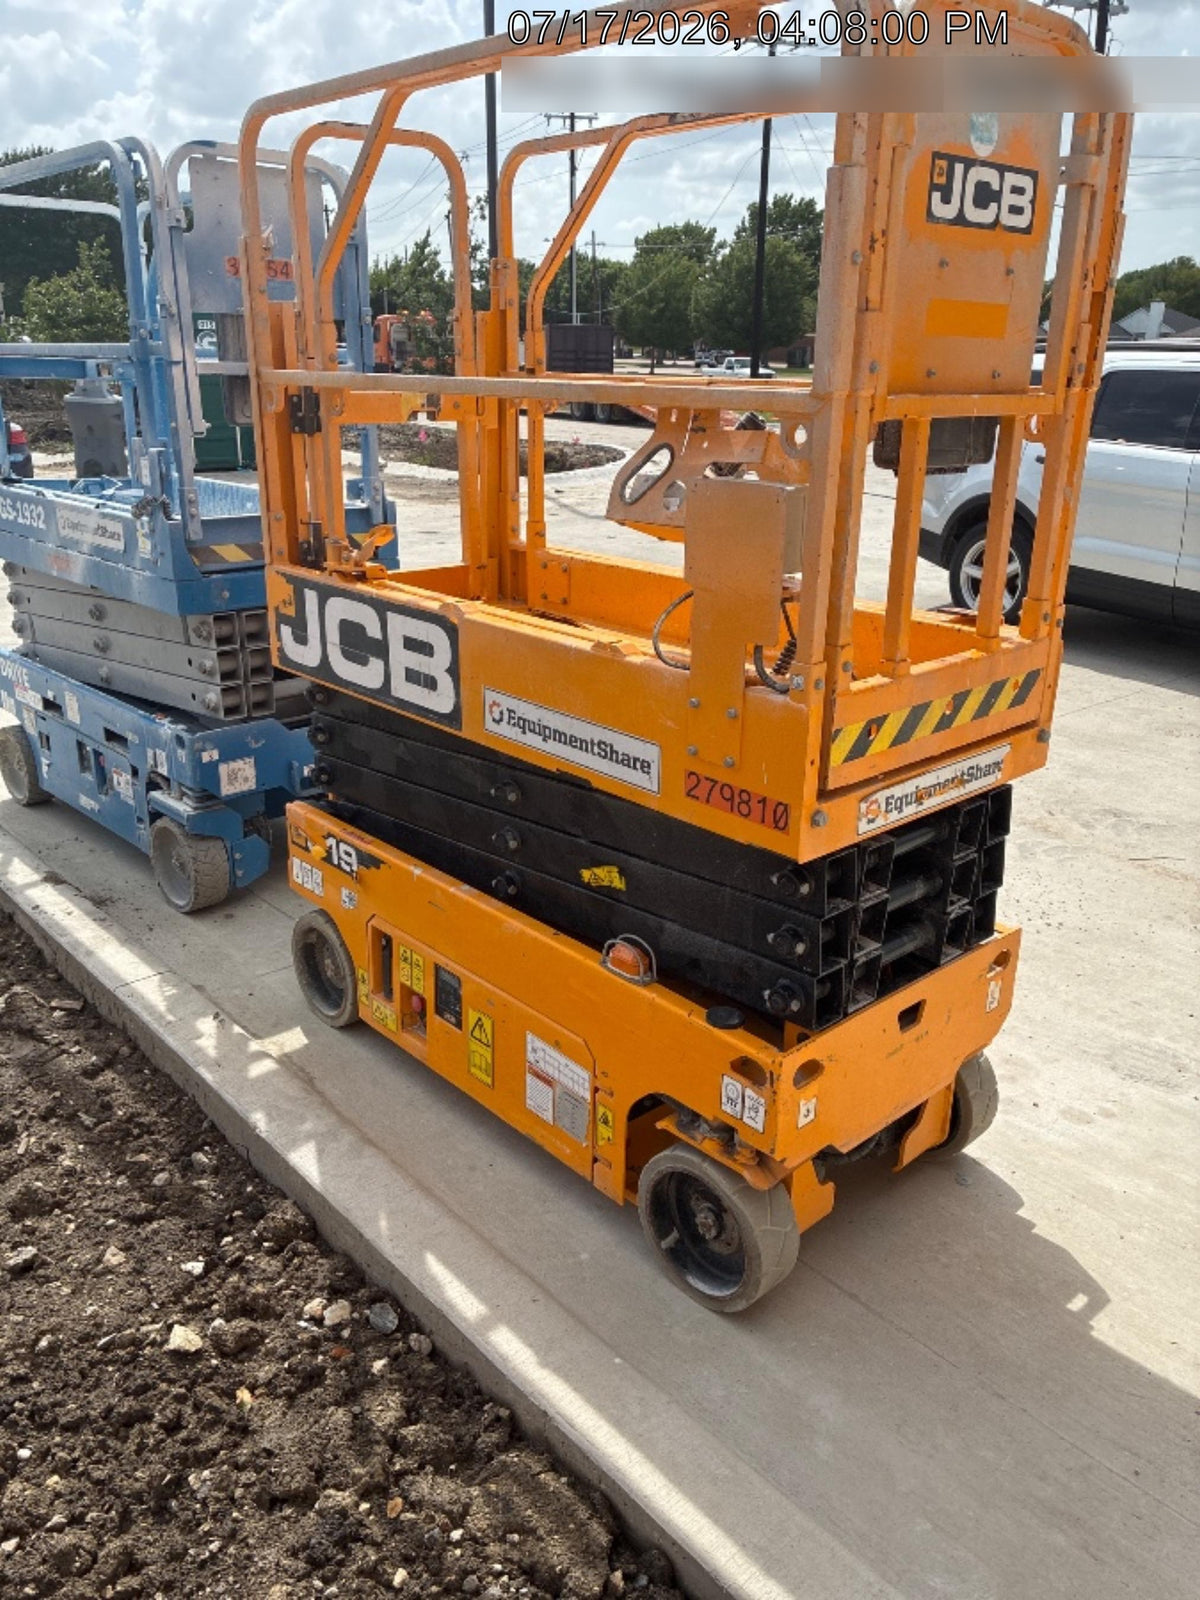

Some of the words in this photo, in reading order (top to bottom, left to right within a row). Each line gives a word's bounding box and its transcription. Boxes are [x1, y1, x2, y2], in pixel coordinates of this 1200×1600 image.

[931, 162, 1035, 229] JCB
[279, 587, 457, 714] JCB
[506, 706, 652, 776] EquipmentShare
[686, 771, 789, 832] 279810
[884, 758, 1004, 815] EquimentShar
[325, 836, 359, 875] 19
